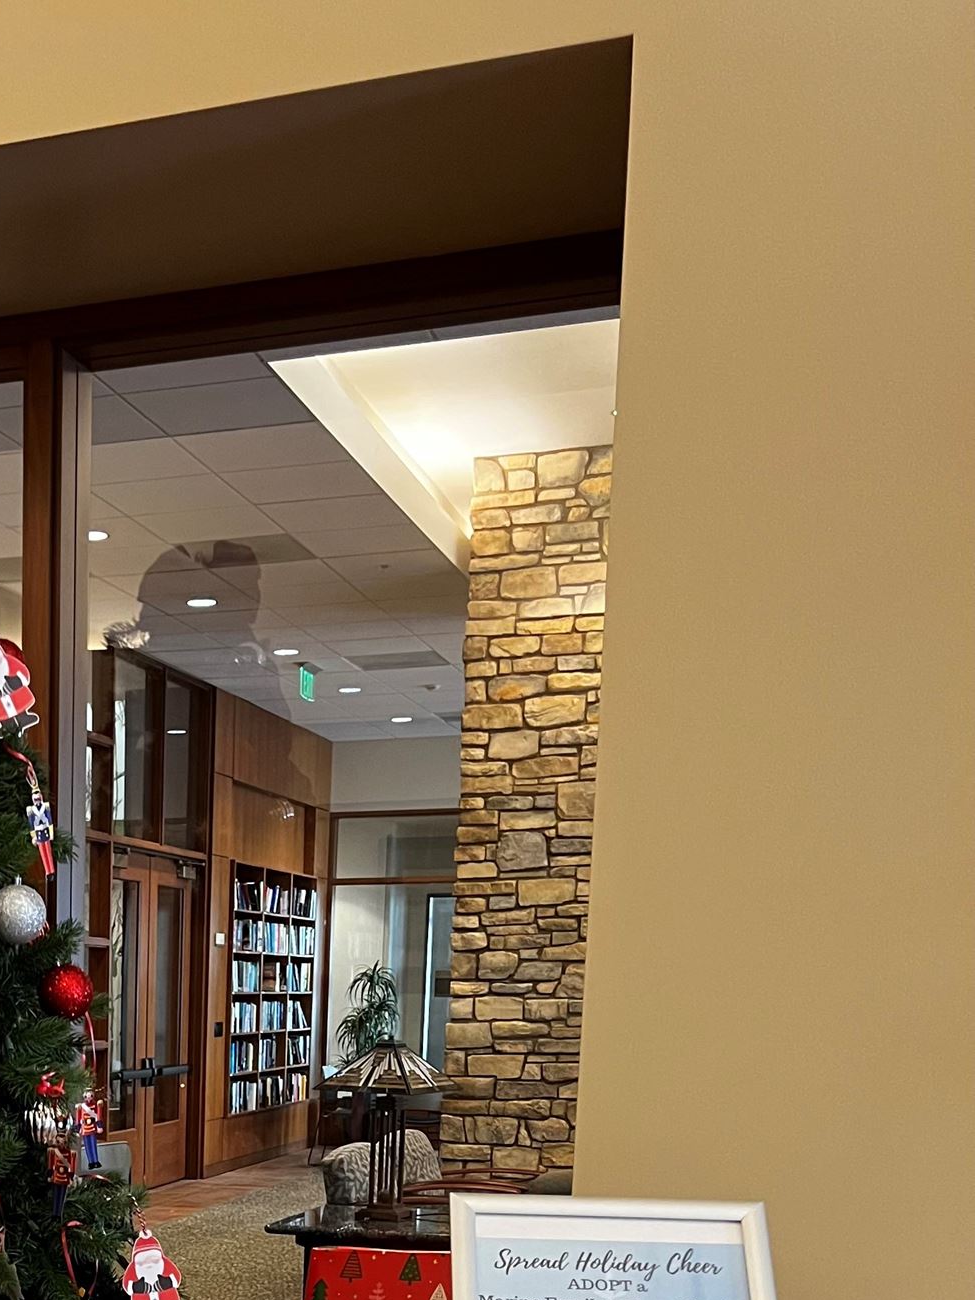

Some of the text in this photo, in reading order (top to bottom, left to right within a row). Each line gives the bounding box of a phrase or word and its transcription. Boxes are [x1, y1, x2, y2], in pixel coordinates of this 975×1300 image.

[494, 1248, 723, 1281] Spread Holiday Cheer
[567, 1278, 648, 1292] ADOPT a
